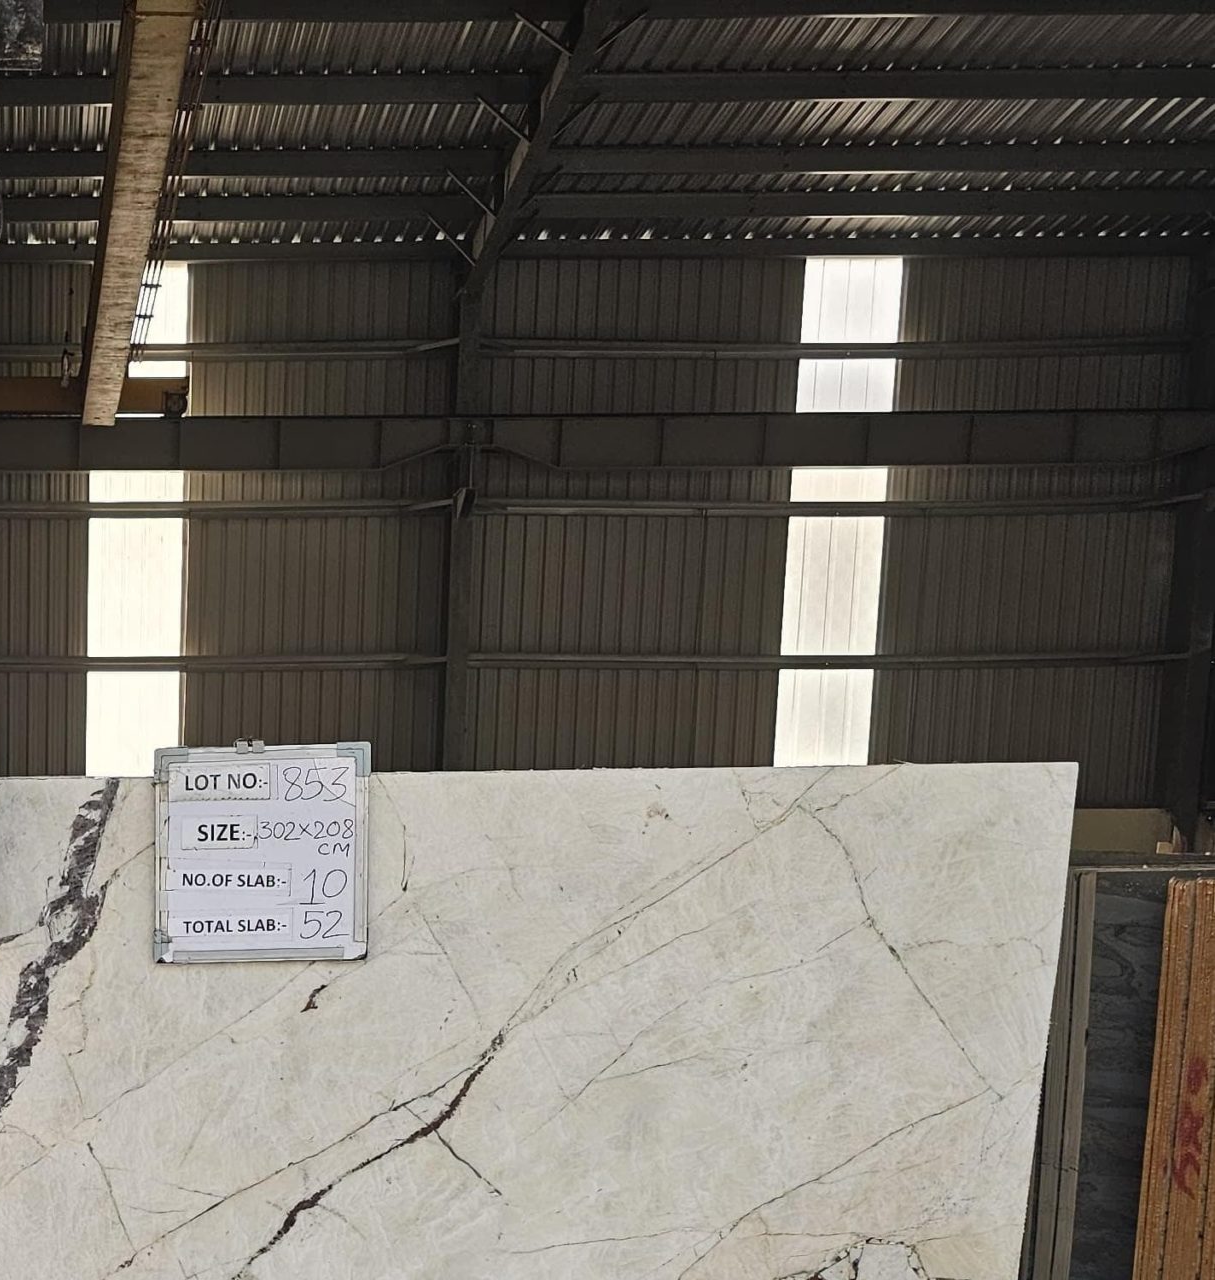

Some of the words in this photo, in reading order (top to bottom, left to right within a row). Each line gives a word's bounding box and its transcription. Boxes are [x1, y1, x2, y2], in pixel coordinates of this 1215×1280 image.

[185, 774, 221, 791] LOT
[283, 767, 350, 801] 853
[318, 843, 350, 857] CM
[182, 874, 233, 887] NO.OF
[299, 869, 348, 905] 10
[183, 921, 233, 934] TOTAL
[300, 911, 350, 939] 52
